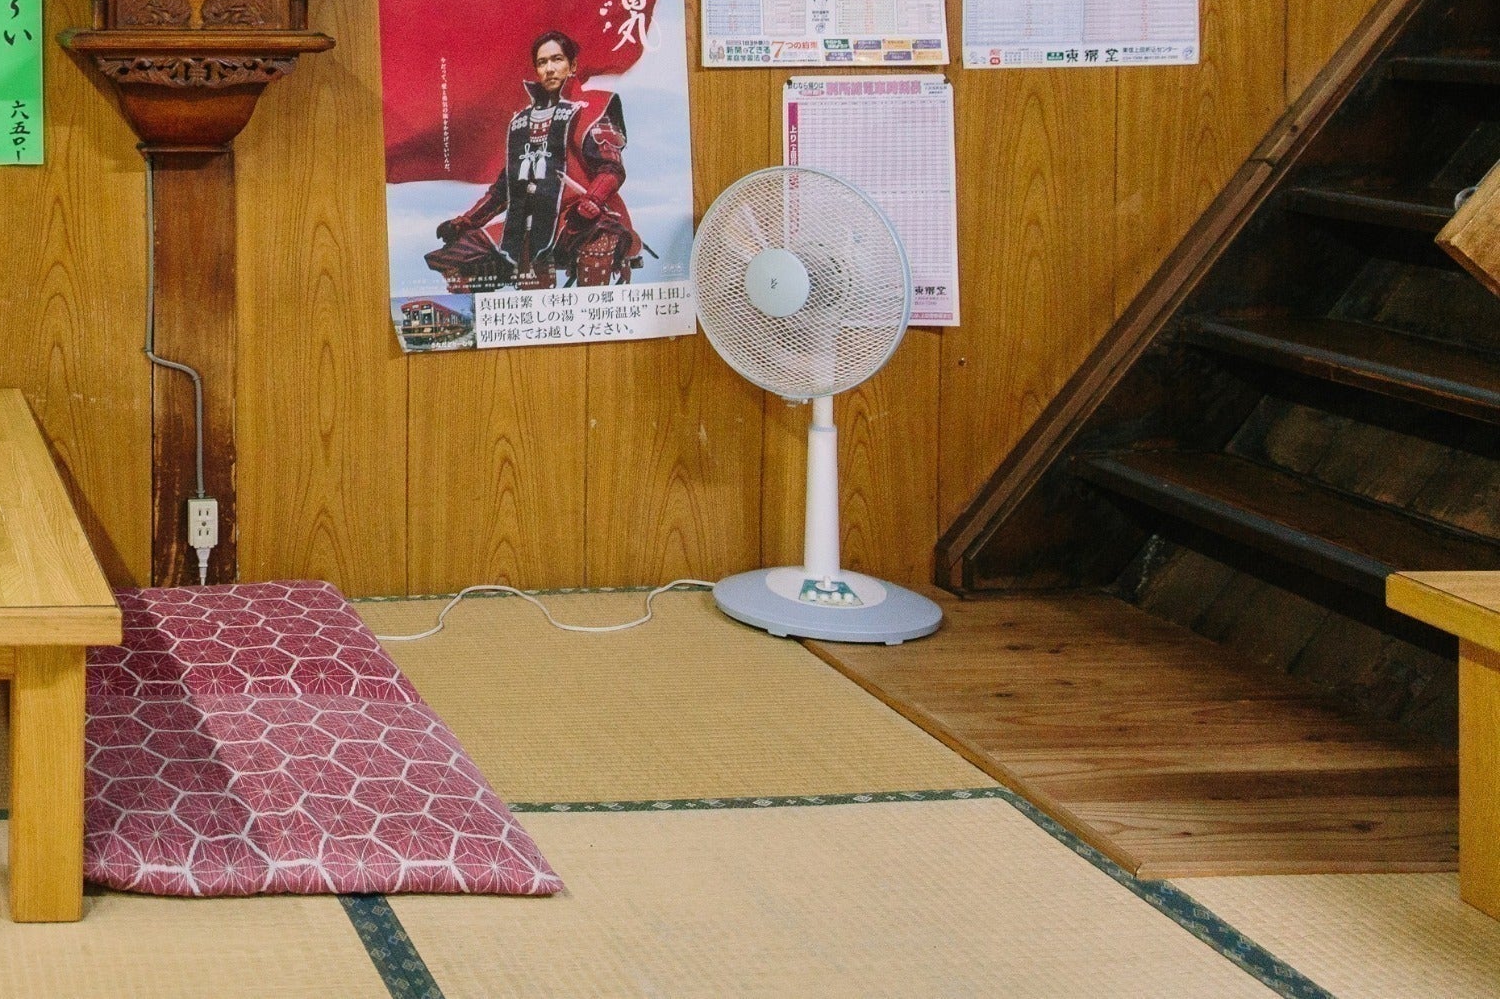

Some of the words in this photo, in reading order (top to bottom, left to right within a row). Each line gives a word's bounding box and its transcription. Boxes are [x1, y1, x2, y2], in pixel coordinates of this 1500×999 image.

[480, 323, 635, 343] 別所線でお越しください。
